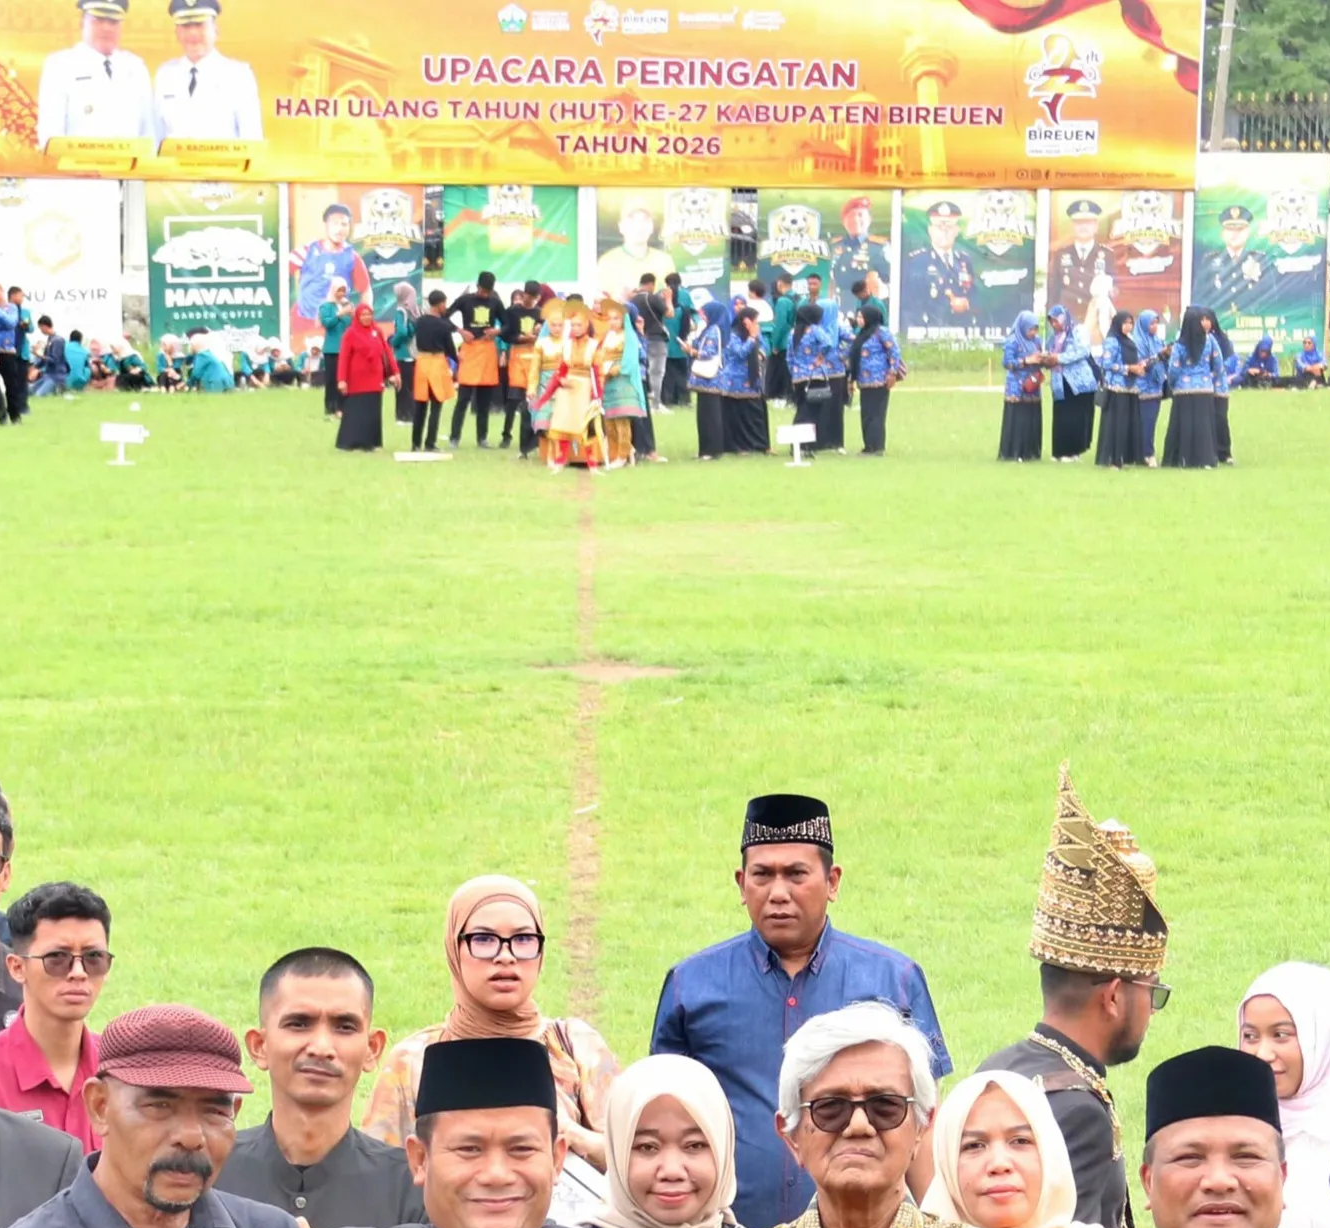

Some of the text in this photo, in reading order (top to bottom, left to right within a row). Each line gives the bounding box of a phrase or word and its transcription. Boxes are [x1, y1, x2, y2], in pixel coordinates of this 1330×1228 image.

[423, 57, 856, 88] UPACARA PERINGATAN
[275, 98, 1004, 125] HARI ULANG TAHUN (HUT) KE-27 KABUPATEN BIREUEN
[556, 135, 721, 155] TAHUN 2026
[54, 288, 108, 301] ASYIR
[165, 287, 273, 308] HAVANA
[173, 310, 263, 320] GARDEN COFFEE
